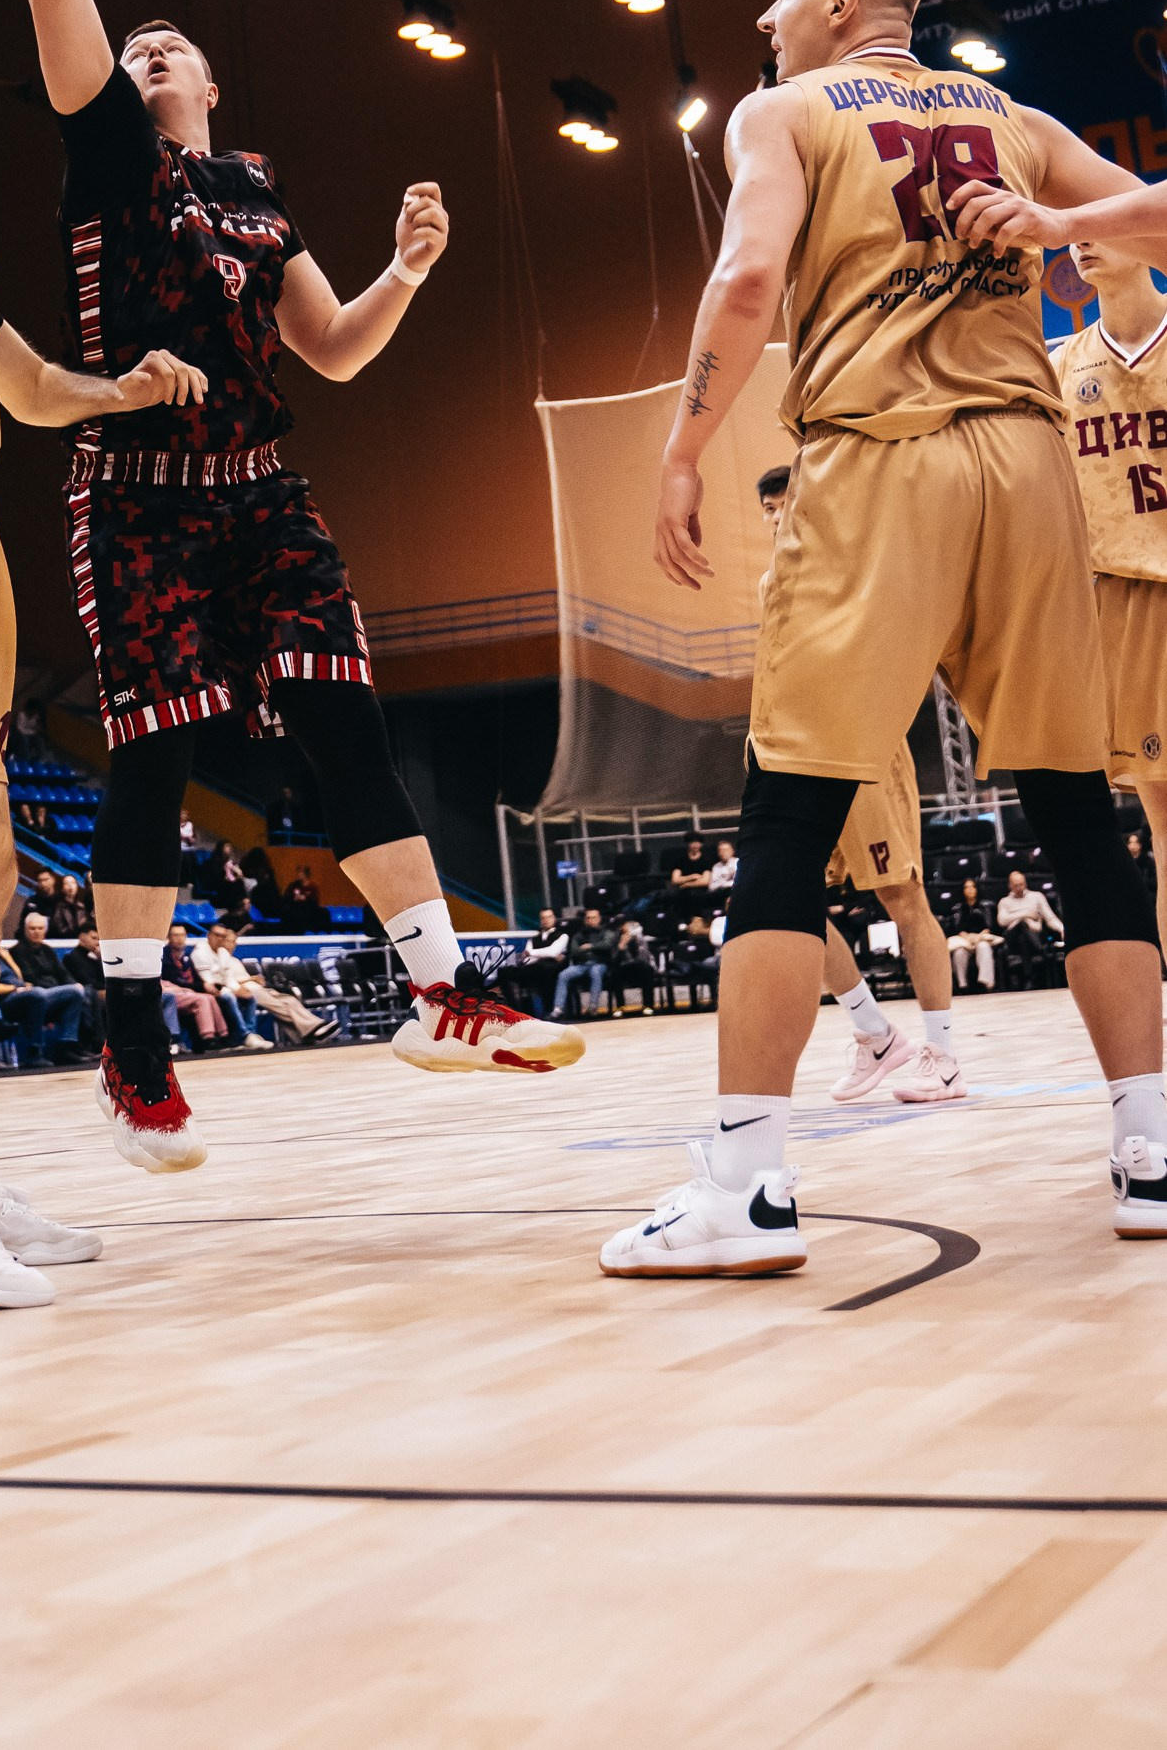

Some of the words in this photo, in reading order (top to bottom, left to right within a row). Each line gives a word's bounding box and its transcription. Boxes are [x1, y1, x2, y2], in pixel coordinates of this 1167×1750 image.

[212, 253, 247, 303] 9
[1127, 463, 1167, 514] 15
[113, 687, 137, 707] STK
[869, 841, 890, 876] 17
